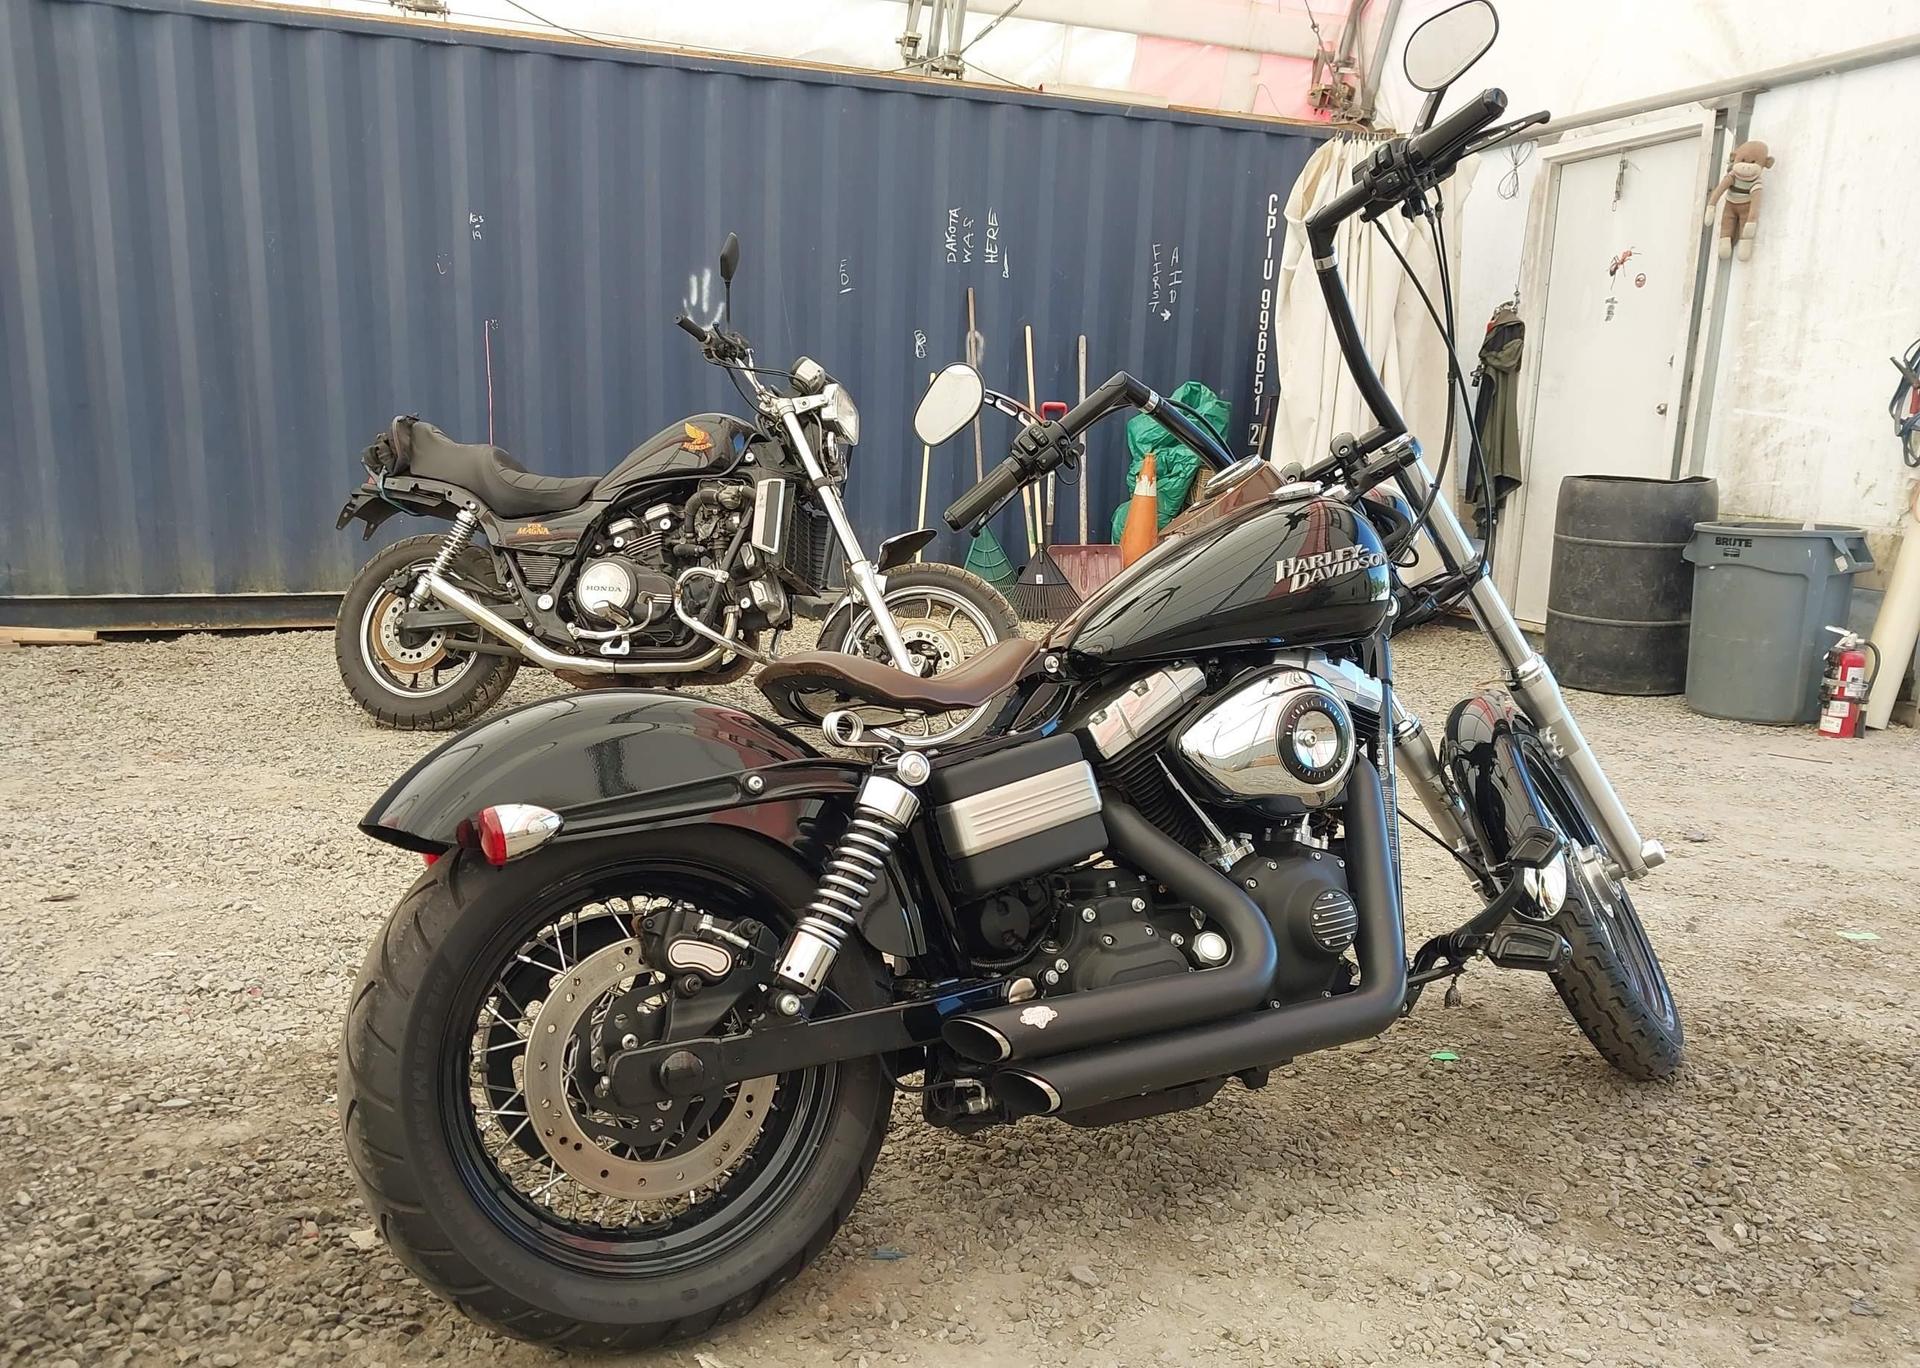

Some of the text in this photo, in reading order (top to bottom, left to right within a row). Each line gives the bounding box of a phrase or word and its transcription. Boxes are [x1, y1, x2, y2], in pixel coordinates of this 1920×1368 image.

[945, 207, 962, 263] DAKOTA
[962, 216, 974, 263] WAS
[984, 206, 1000, 264] HERE
[1149, 243, 1163, 313] FIRST
[1169, 246, 1183, 303] AID
[1249, 193, 1279, 446] CPIU 996651 2
[1715, 536, 1753, 547] BRUTE
[585, 585, 622, 593] HONDA
[1289, 551, 1388, 594] DAVIDSON
